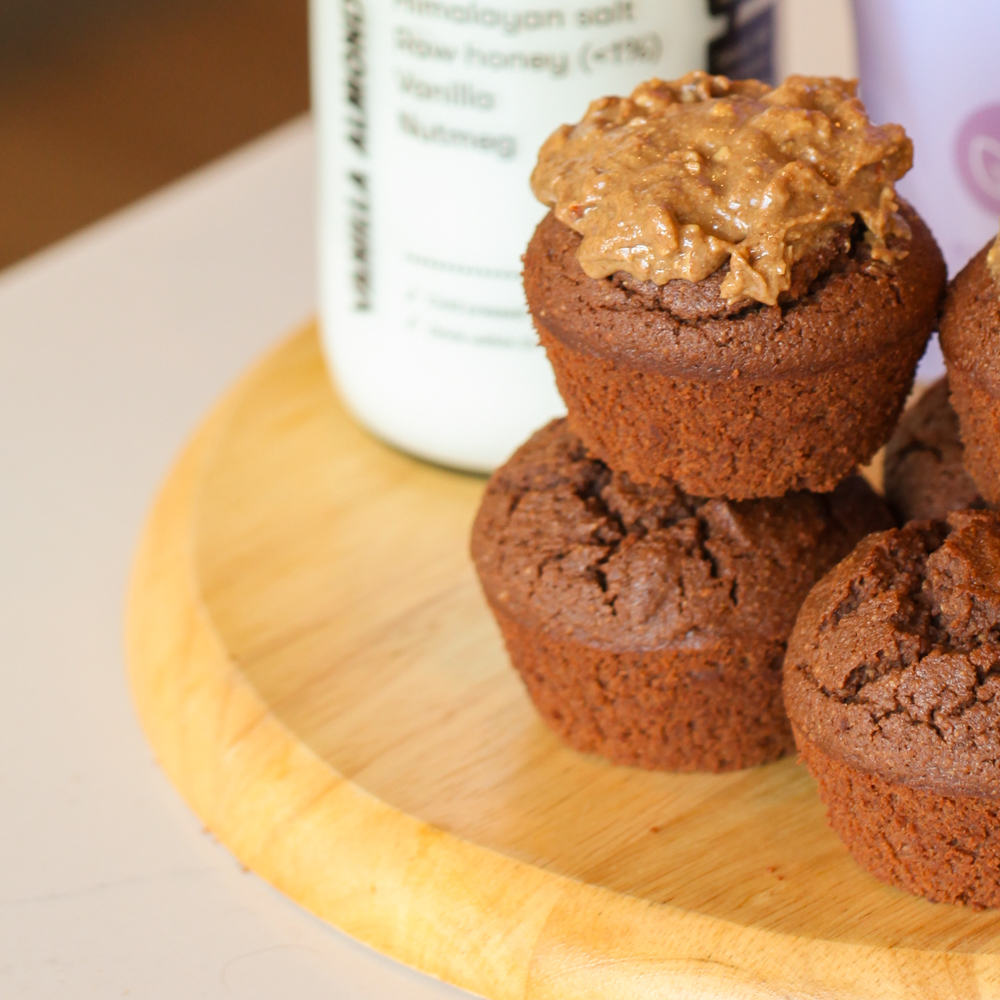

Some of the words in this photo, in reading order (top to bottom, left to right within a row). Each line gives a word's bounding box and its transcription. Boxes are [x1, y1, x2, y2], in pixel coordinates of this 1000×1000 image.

[397, 27, 455, 62] Raw
[463, 42, 570, 77] honey
[398, 71, 495, 108] Vanilla
[400, 113, 516, 159] Nutmeg
[346, 169, 373, 314] VANILLA
